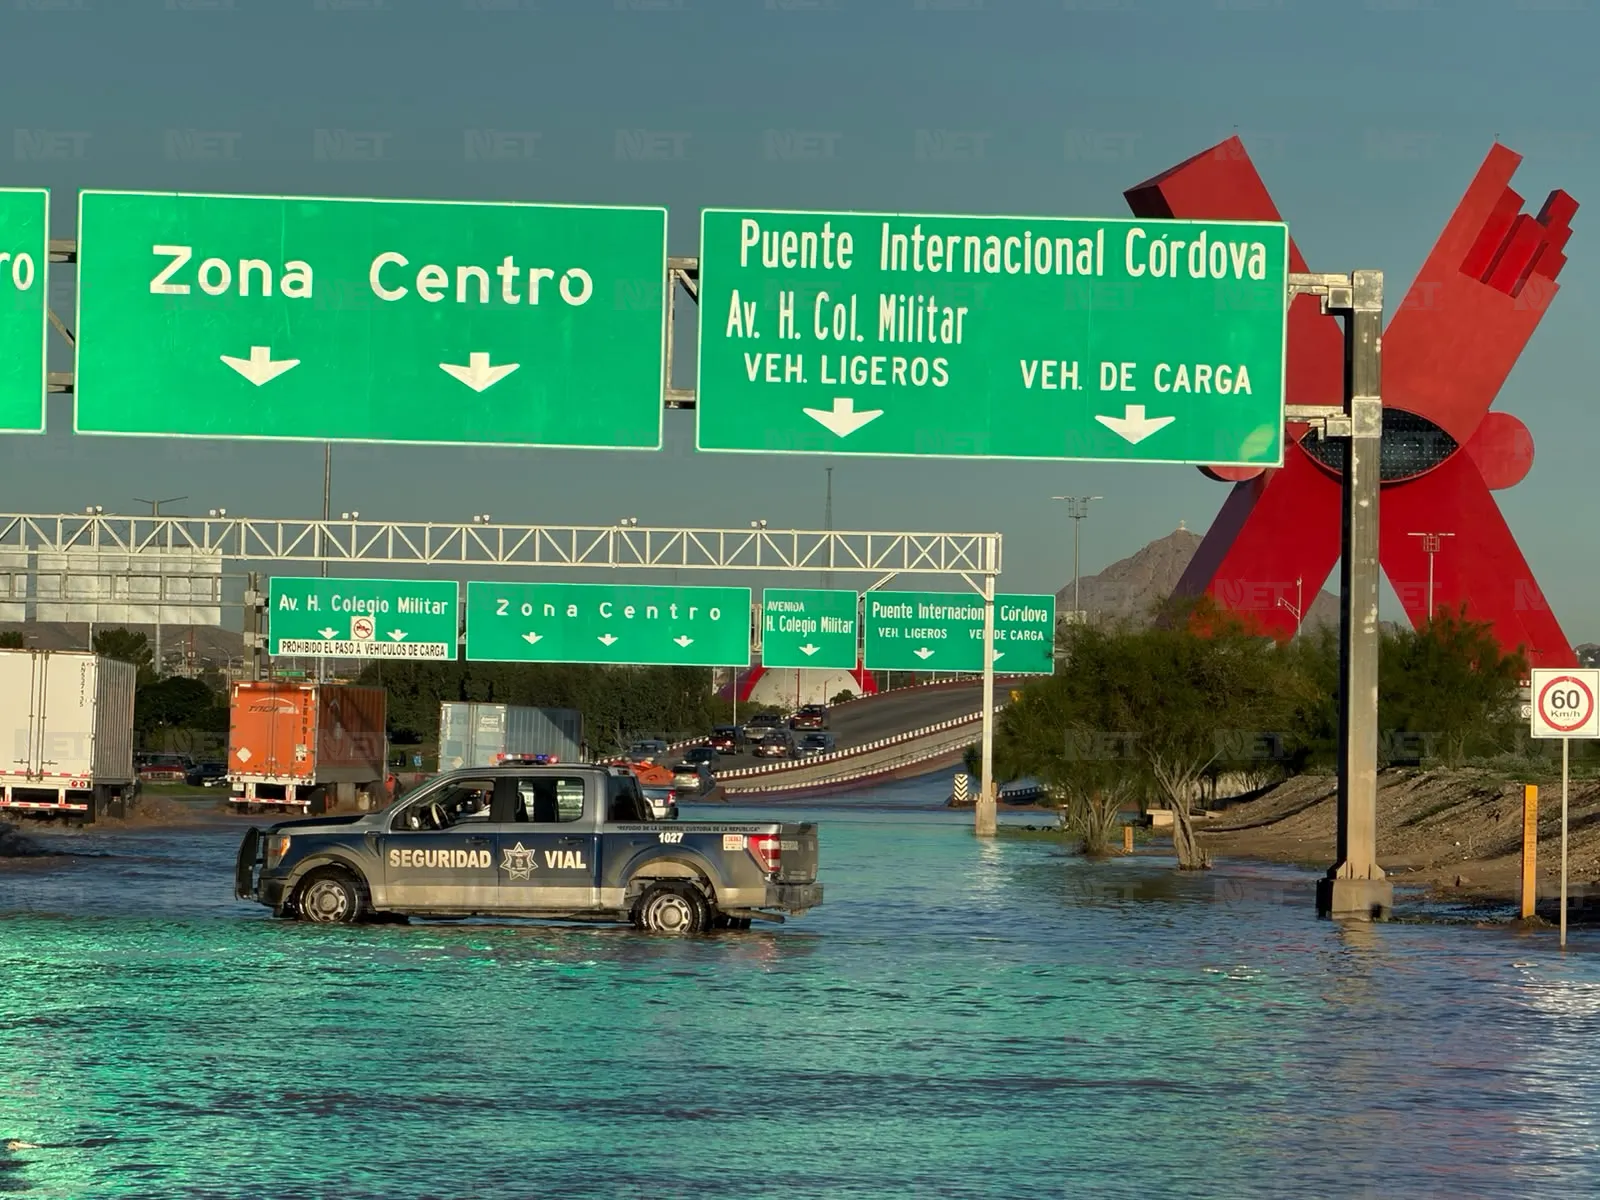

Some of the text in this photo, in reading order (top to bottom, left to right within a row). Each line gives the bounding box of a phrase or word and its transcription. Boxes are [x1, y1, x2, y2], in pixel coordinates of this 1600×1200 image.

[741, 219, 1267, 280] Puente Internacional Córdova
[150, 245, 592, 305] Zona Centro
[727, 290, 968, 343] Av. H. Col. Militar
[744, 353, 948, 386] VEH. LIGEROS
[1021, 360, 1251, 394] VEH. DE CARGA
[279, 594, 449, 617] Av. H. Colegio Militar
[496, 598, 721, 621] Zona Centro
[766, 600, 805, 612] AVENIDA
[872, 601, 1048, 623] Puente Internacion Córdova
[766, 613, 854, 638] H. Colegio Militar
[878, 627, 948, 639] VEH. LIGEROS
[969, 628, 1044, 641] VE DE CARGA
[282, 640, 445, 657] PROHIBIDO EL PASO A VEHICULOS DE CARGA
[1551, 689, 1580, 710] 60
[1550, 710, 1581, 718] Km/h
[658, 832, 684, 844] 1027
[389, 849, 587, 869] SEGURIDAD VIAL
